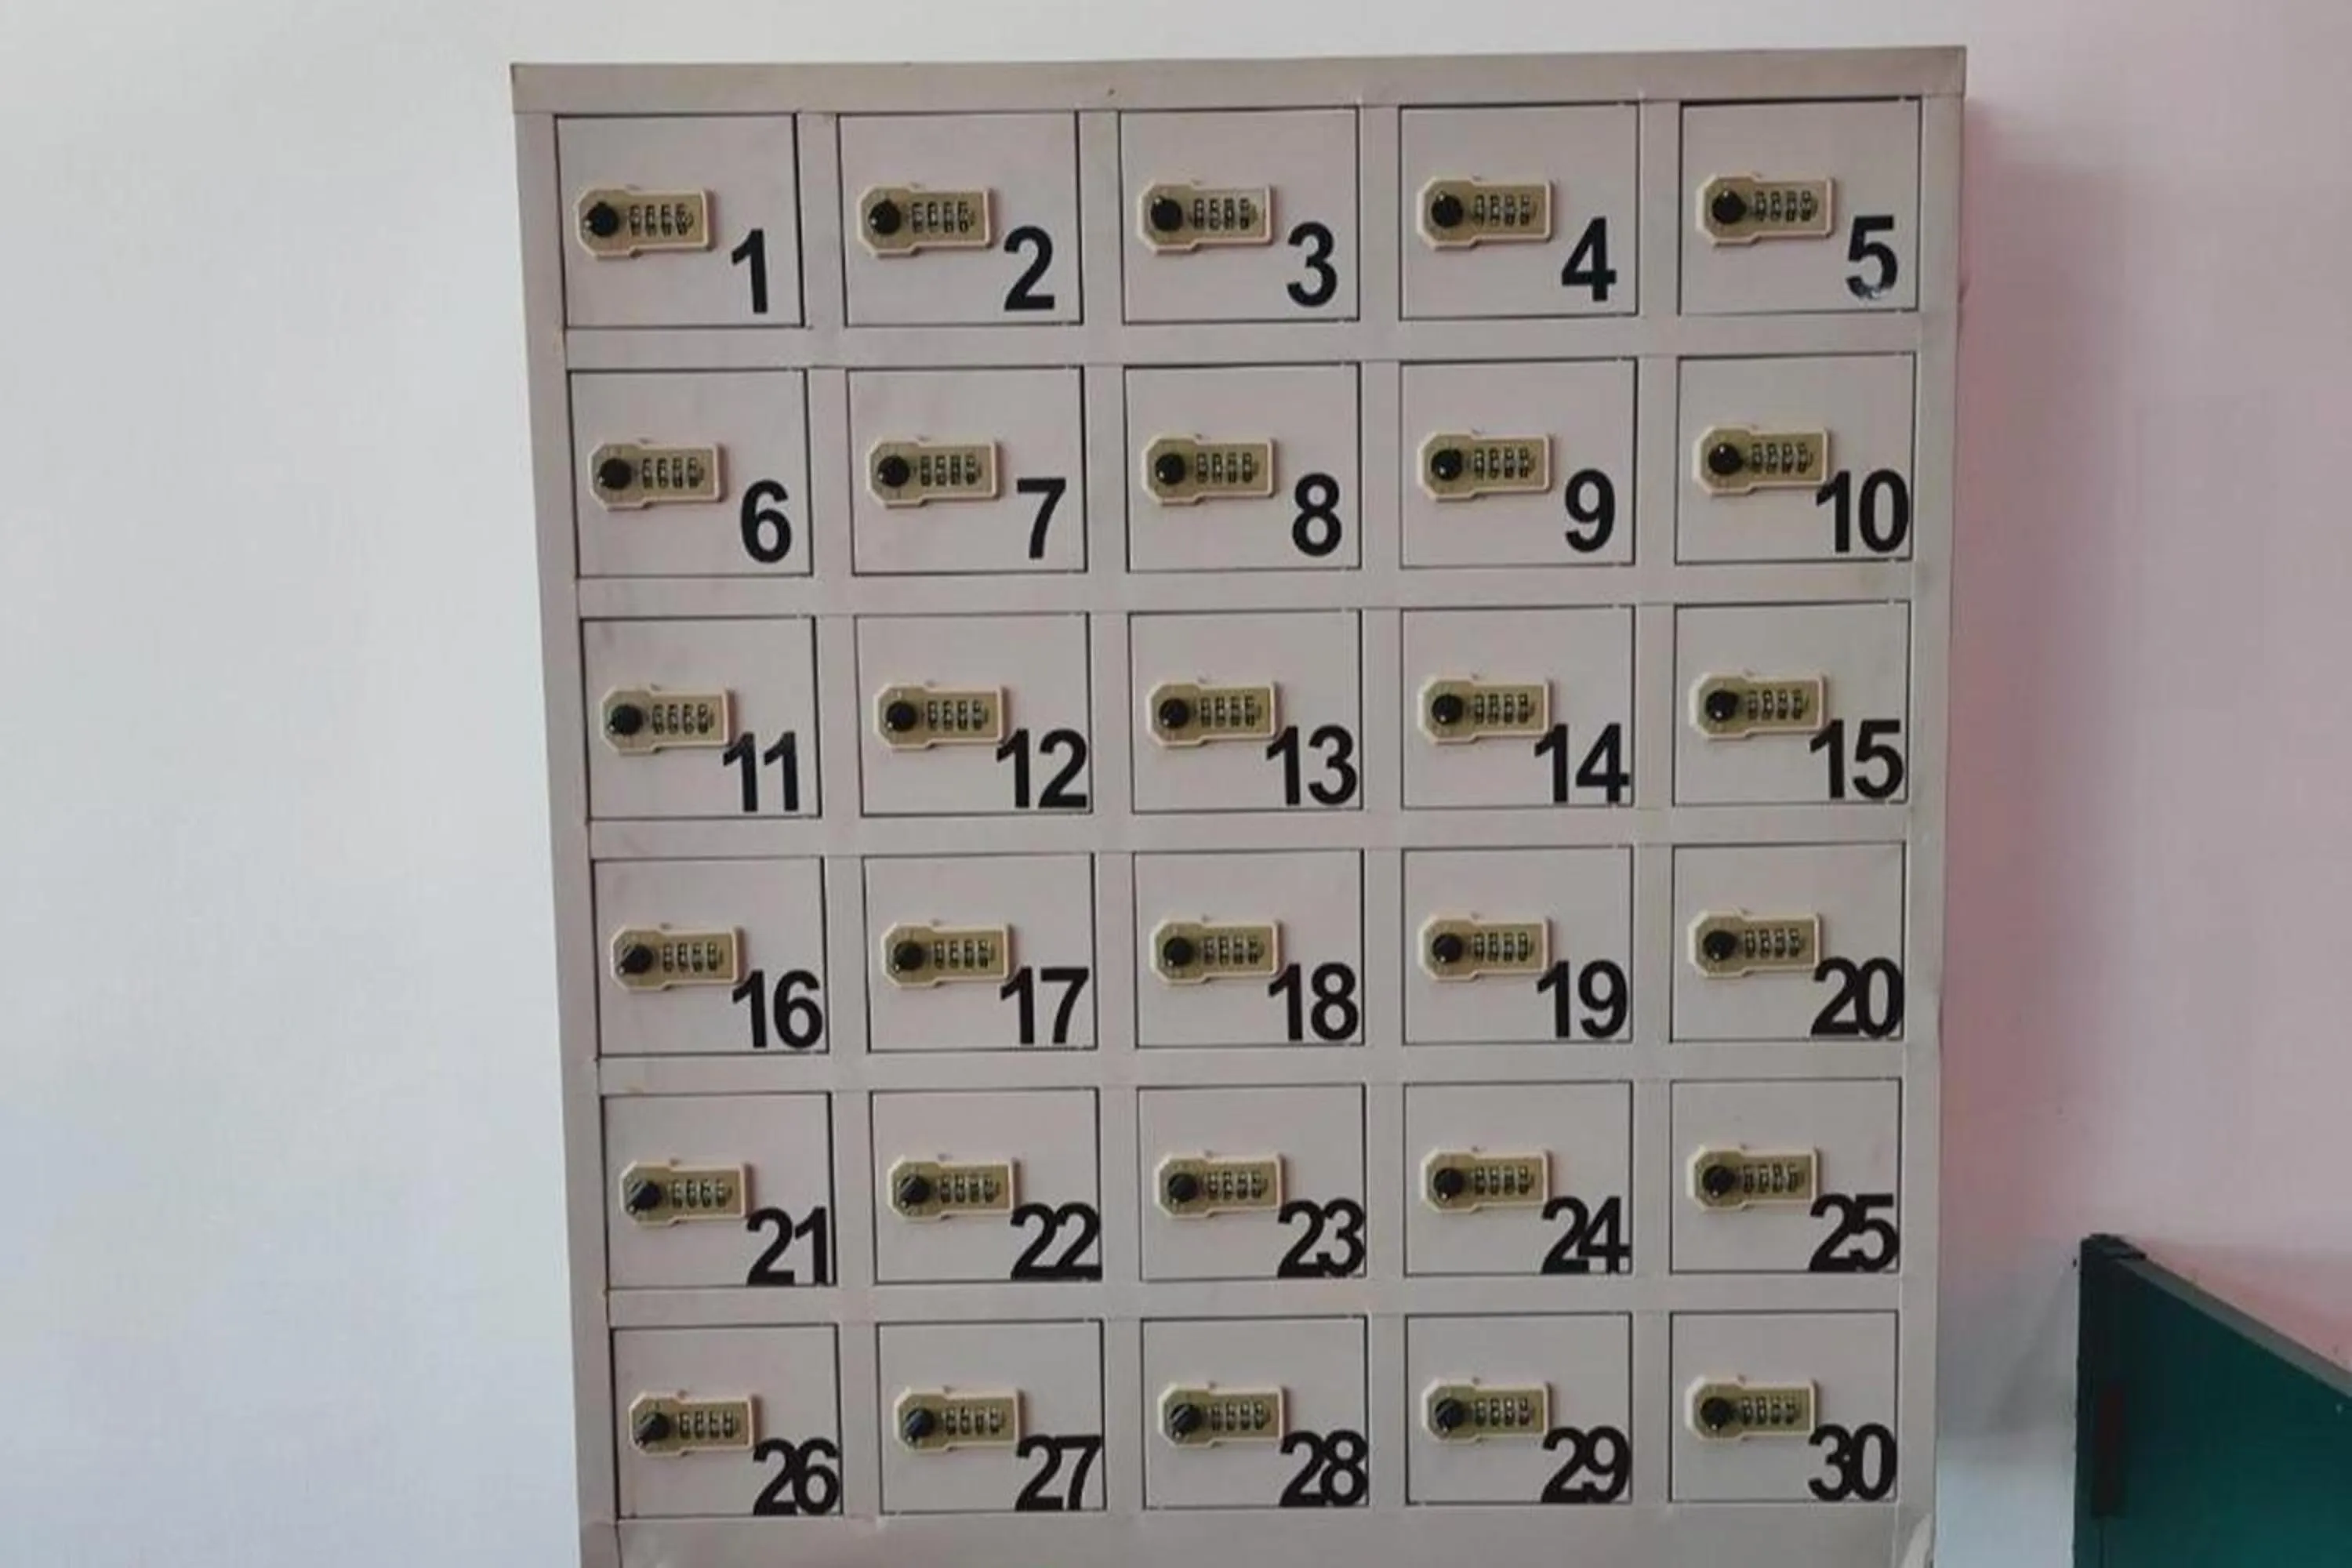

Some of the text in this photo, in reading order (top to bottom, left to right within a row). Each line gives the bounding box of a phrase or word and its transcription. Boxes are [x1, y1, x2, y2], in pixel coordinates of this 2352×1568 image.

[732, 230, 768, 314] 1
[1005, 227, 1055, 312] 2
[1288, 223, 1338, 308] 3
[1562, 218, 1617, 303] 4
[1847, 215, 1899, 300] 5
[741, 481, 793, 564] 6
[1018, 478, 1067, 560] 7
[1293, 474, 1343, 557] 8
[1566, 470, 1616, 554] 9
[1815, 469, 1911, 554] 10
[724, 732, 800, 813] 11
[997, 729, 1088, 810] 12
[1266, 725, 1358, 807] 13
[1534, 723, 1629, 805] 14
[1809, 719, 1904, 804] 15
[733, 971, 824, 1050] 16
[1001, 967, 1090, 1046] 17
[1269, 963, 1359, 1043] 18
[1537, 960, 1629, 1040] 19
[1810, 957, 1905, 1040] 20
[746, 1207, 829, 1288] 21
[1011, 1203, 1104, 1283] 22
[1278, 1199, 1368, 1280] 23
[1542, 1196, 1634, 1276] 24
[1808, 1192, 1899, 1275] 25
[753, 1439, 840, 1518] 26
[1015, 1434, 1102, 1513] 27
[1280, 1430, 1370, 1509] 28
[1541, 1426, 1635, 1506] 29
[1807, 1423, 1899, 1504] 30
